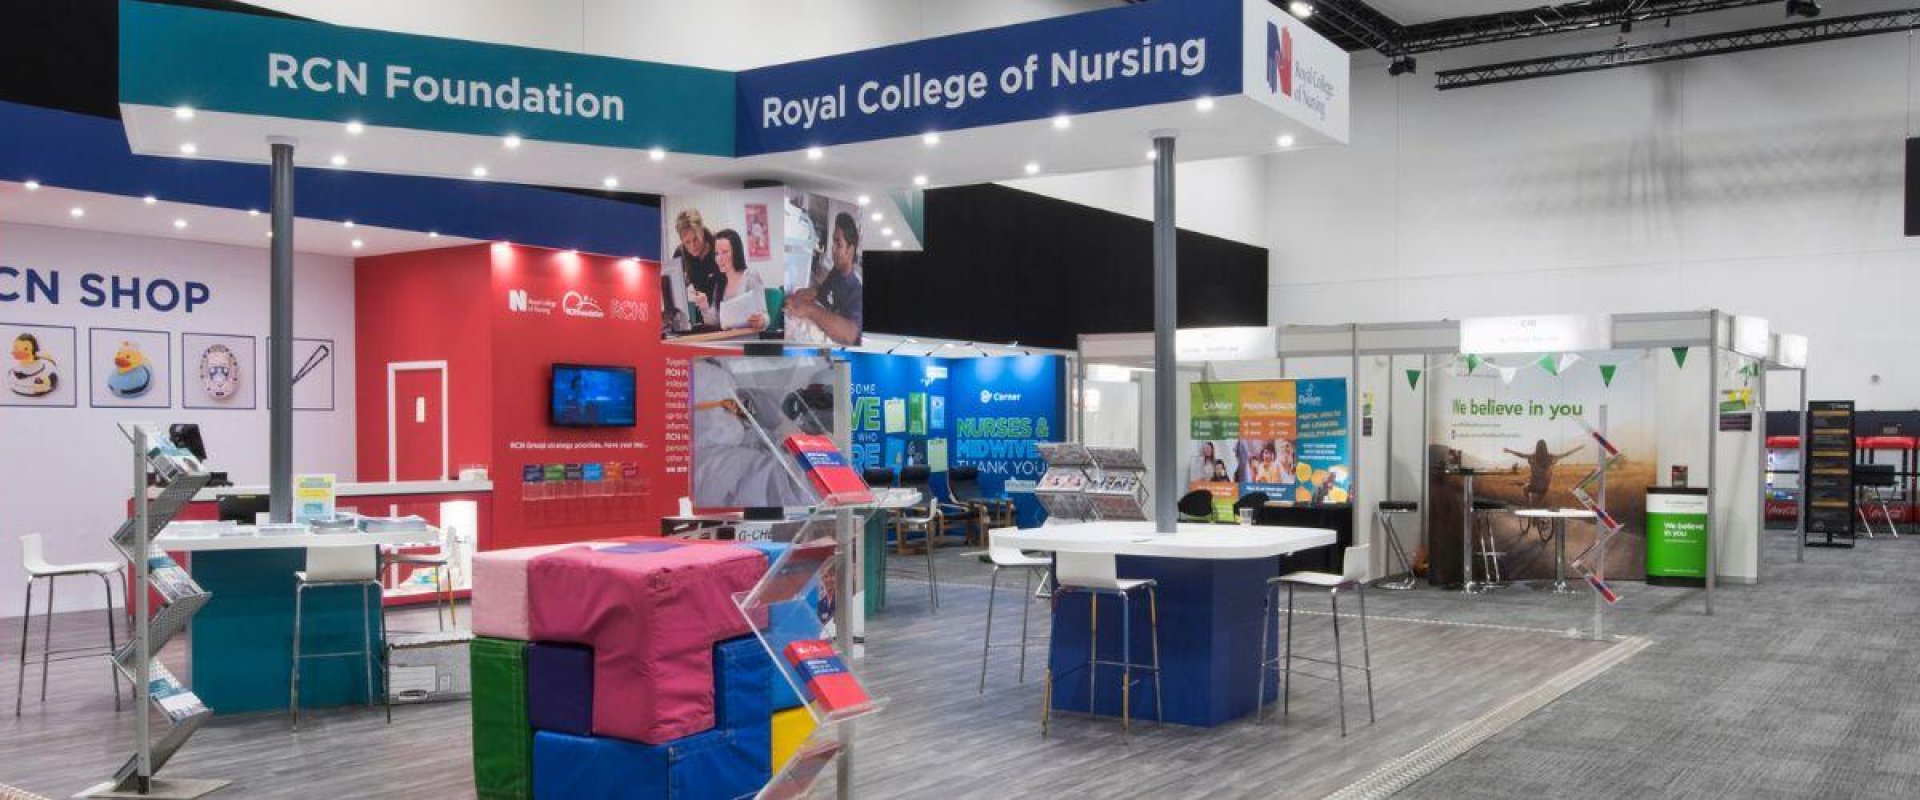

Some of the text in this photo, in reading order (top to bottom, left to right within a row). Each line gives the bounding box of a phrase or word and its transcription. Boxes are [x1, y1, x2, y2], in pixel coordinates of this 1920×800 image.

[268, 53, 625, 121] RCN Foundation
[762, 36, 1207, 129] Royal College of Nursing
[79, 272, 210, 313] SHOP
[956, 417, 1049, 438] NURSES &
[1470, 398, 1524, 416] believe
[1529, 400, 1543, 415] in
[1549, 403, 1583, 420] you
